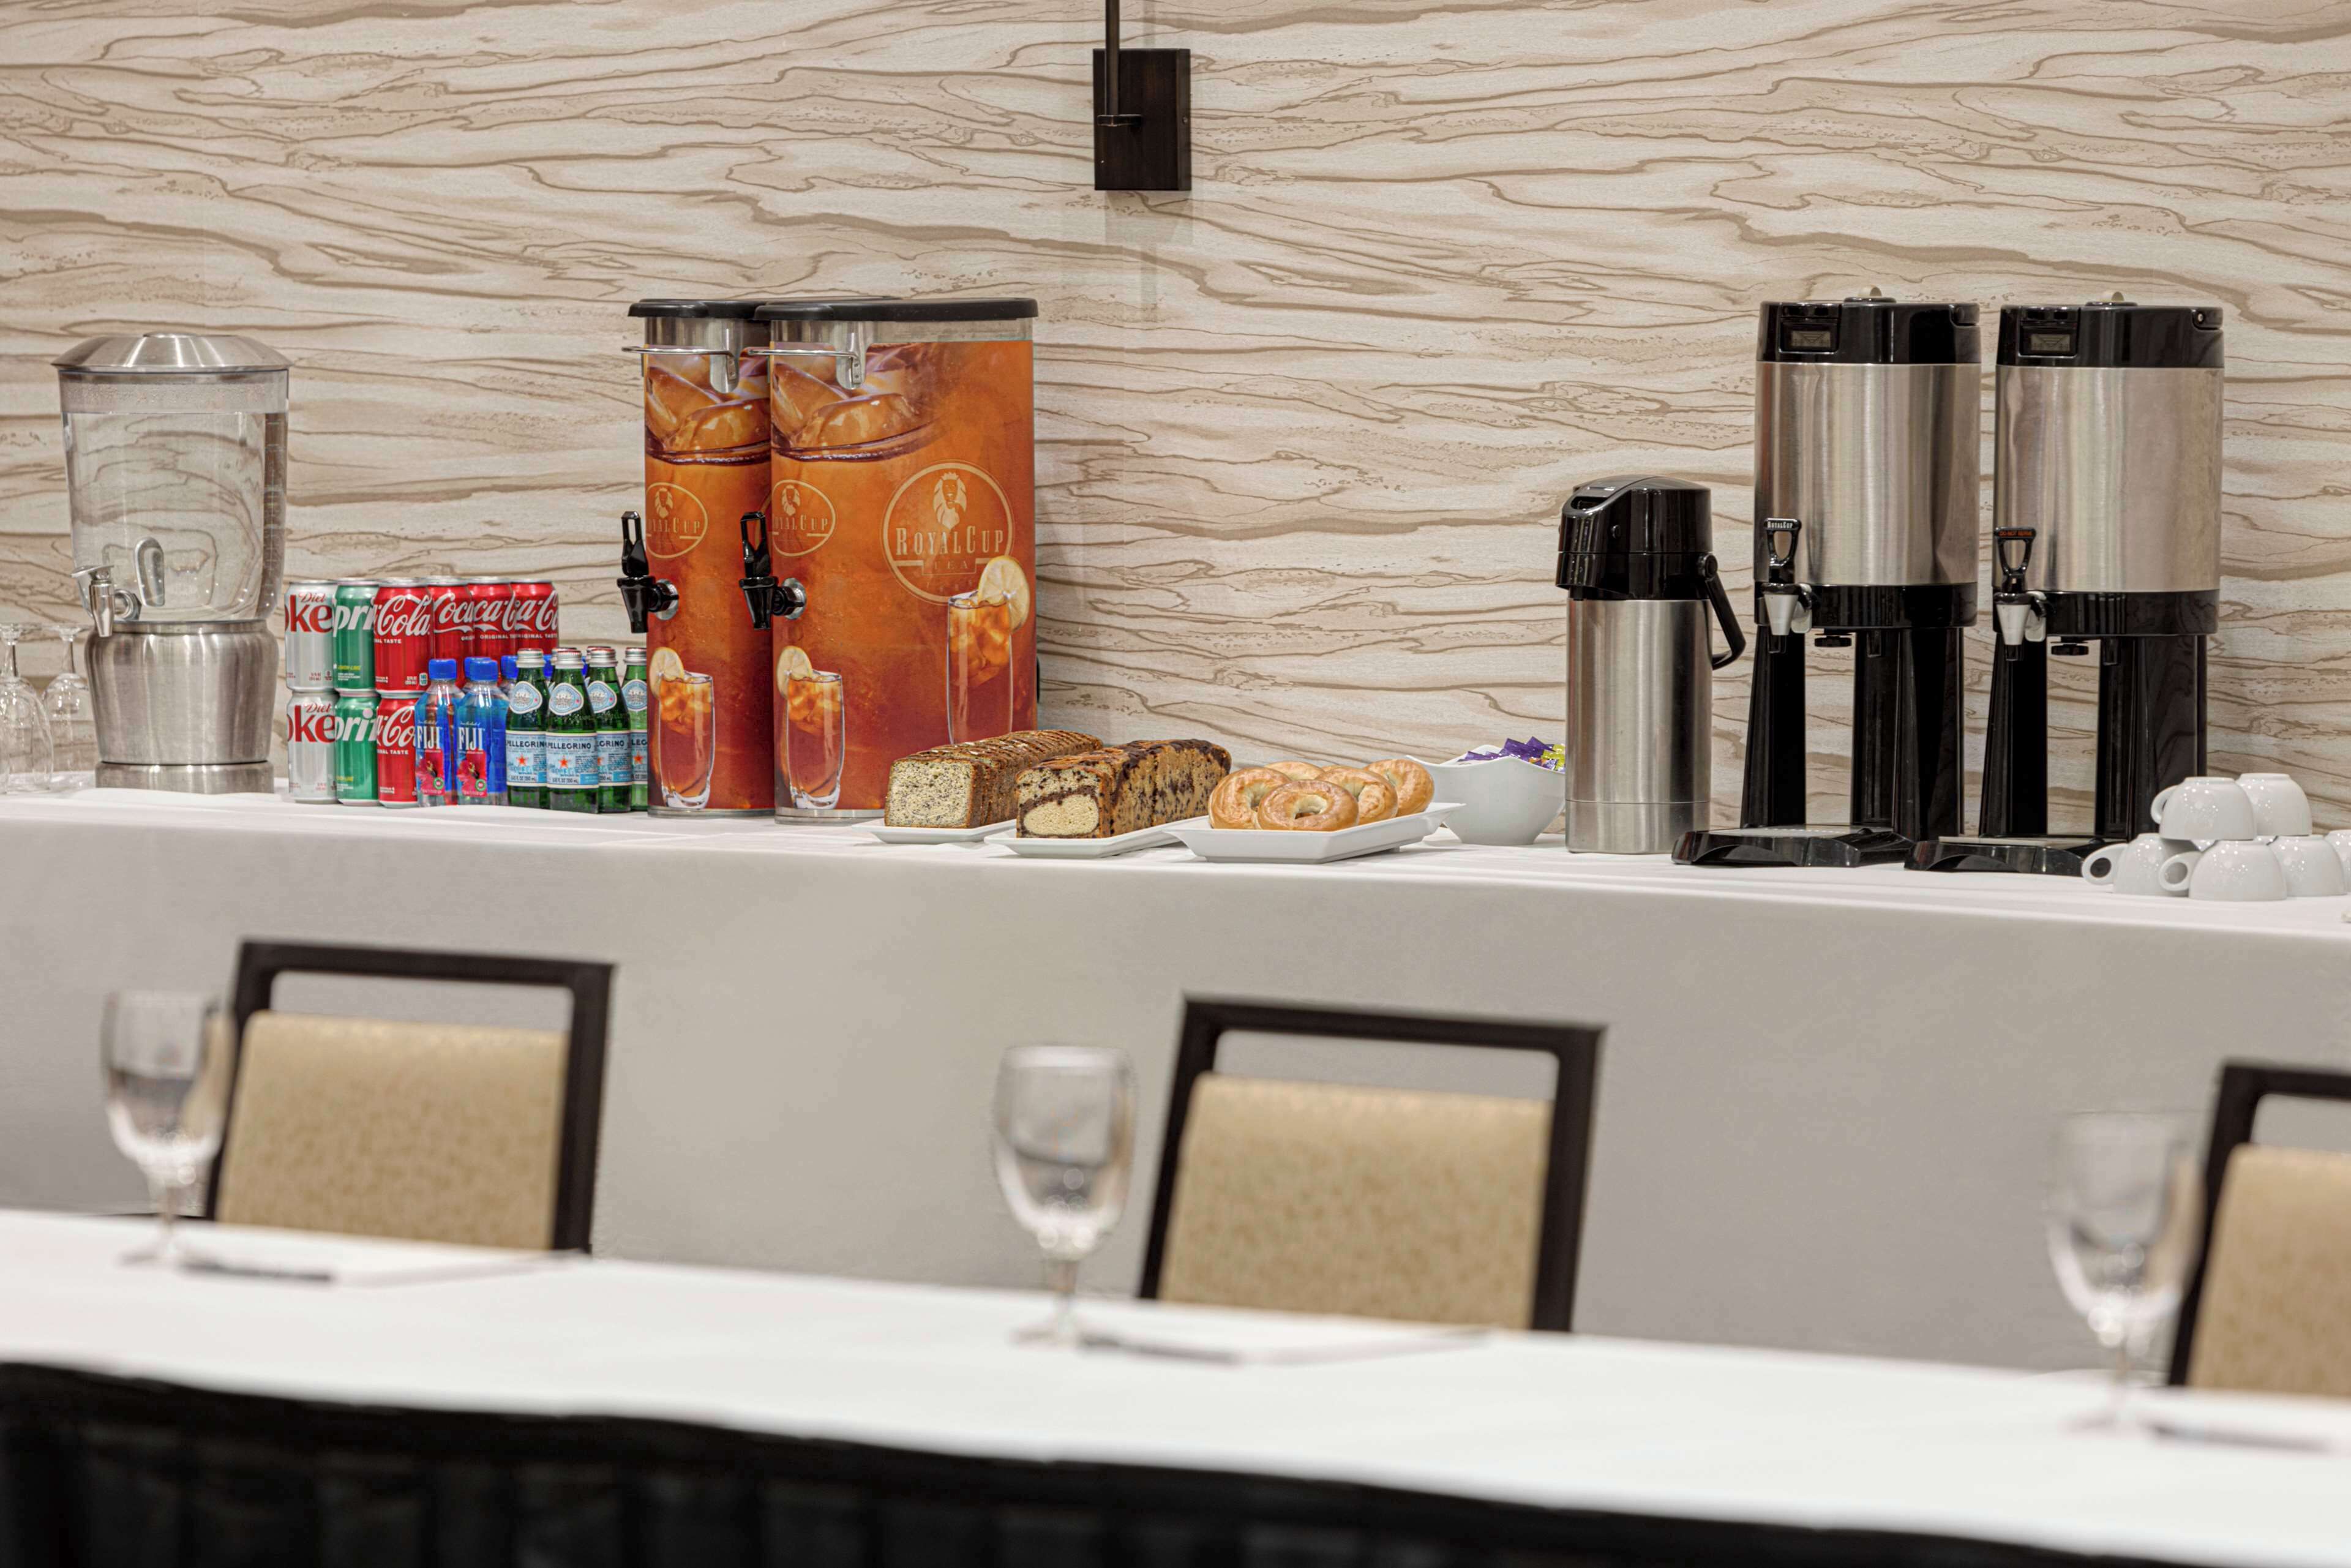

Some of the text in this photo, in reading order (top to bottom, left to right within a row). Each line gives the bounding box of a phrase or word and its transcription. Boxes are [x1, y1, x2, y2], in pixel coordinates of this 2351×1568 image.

[299, 592, 326, 603] Diet
[285, 594, 333, 633] ke
[332, 596, 375, 637] pri
[304, 703, 332, 713] Diet
[287, 705, 336, 743] ke
[417, 726, 440, 749] FIJI
[458, 727, 482, 751] FIJI
